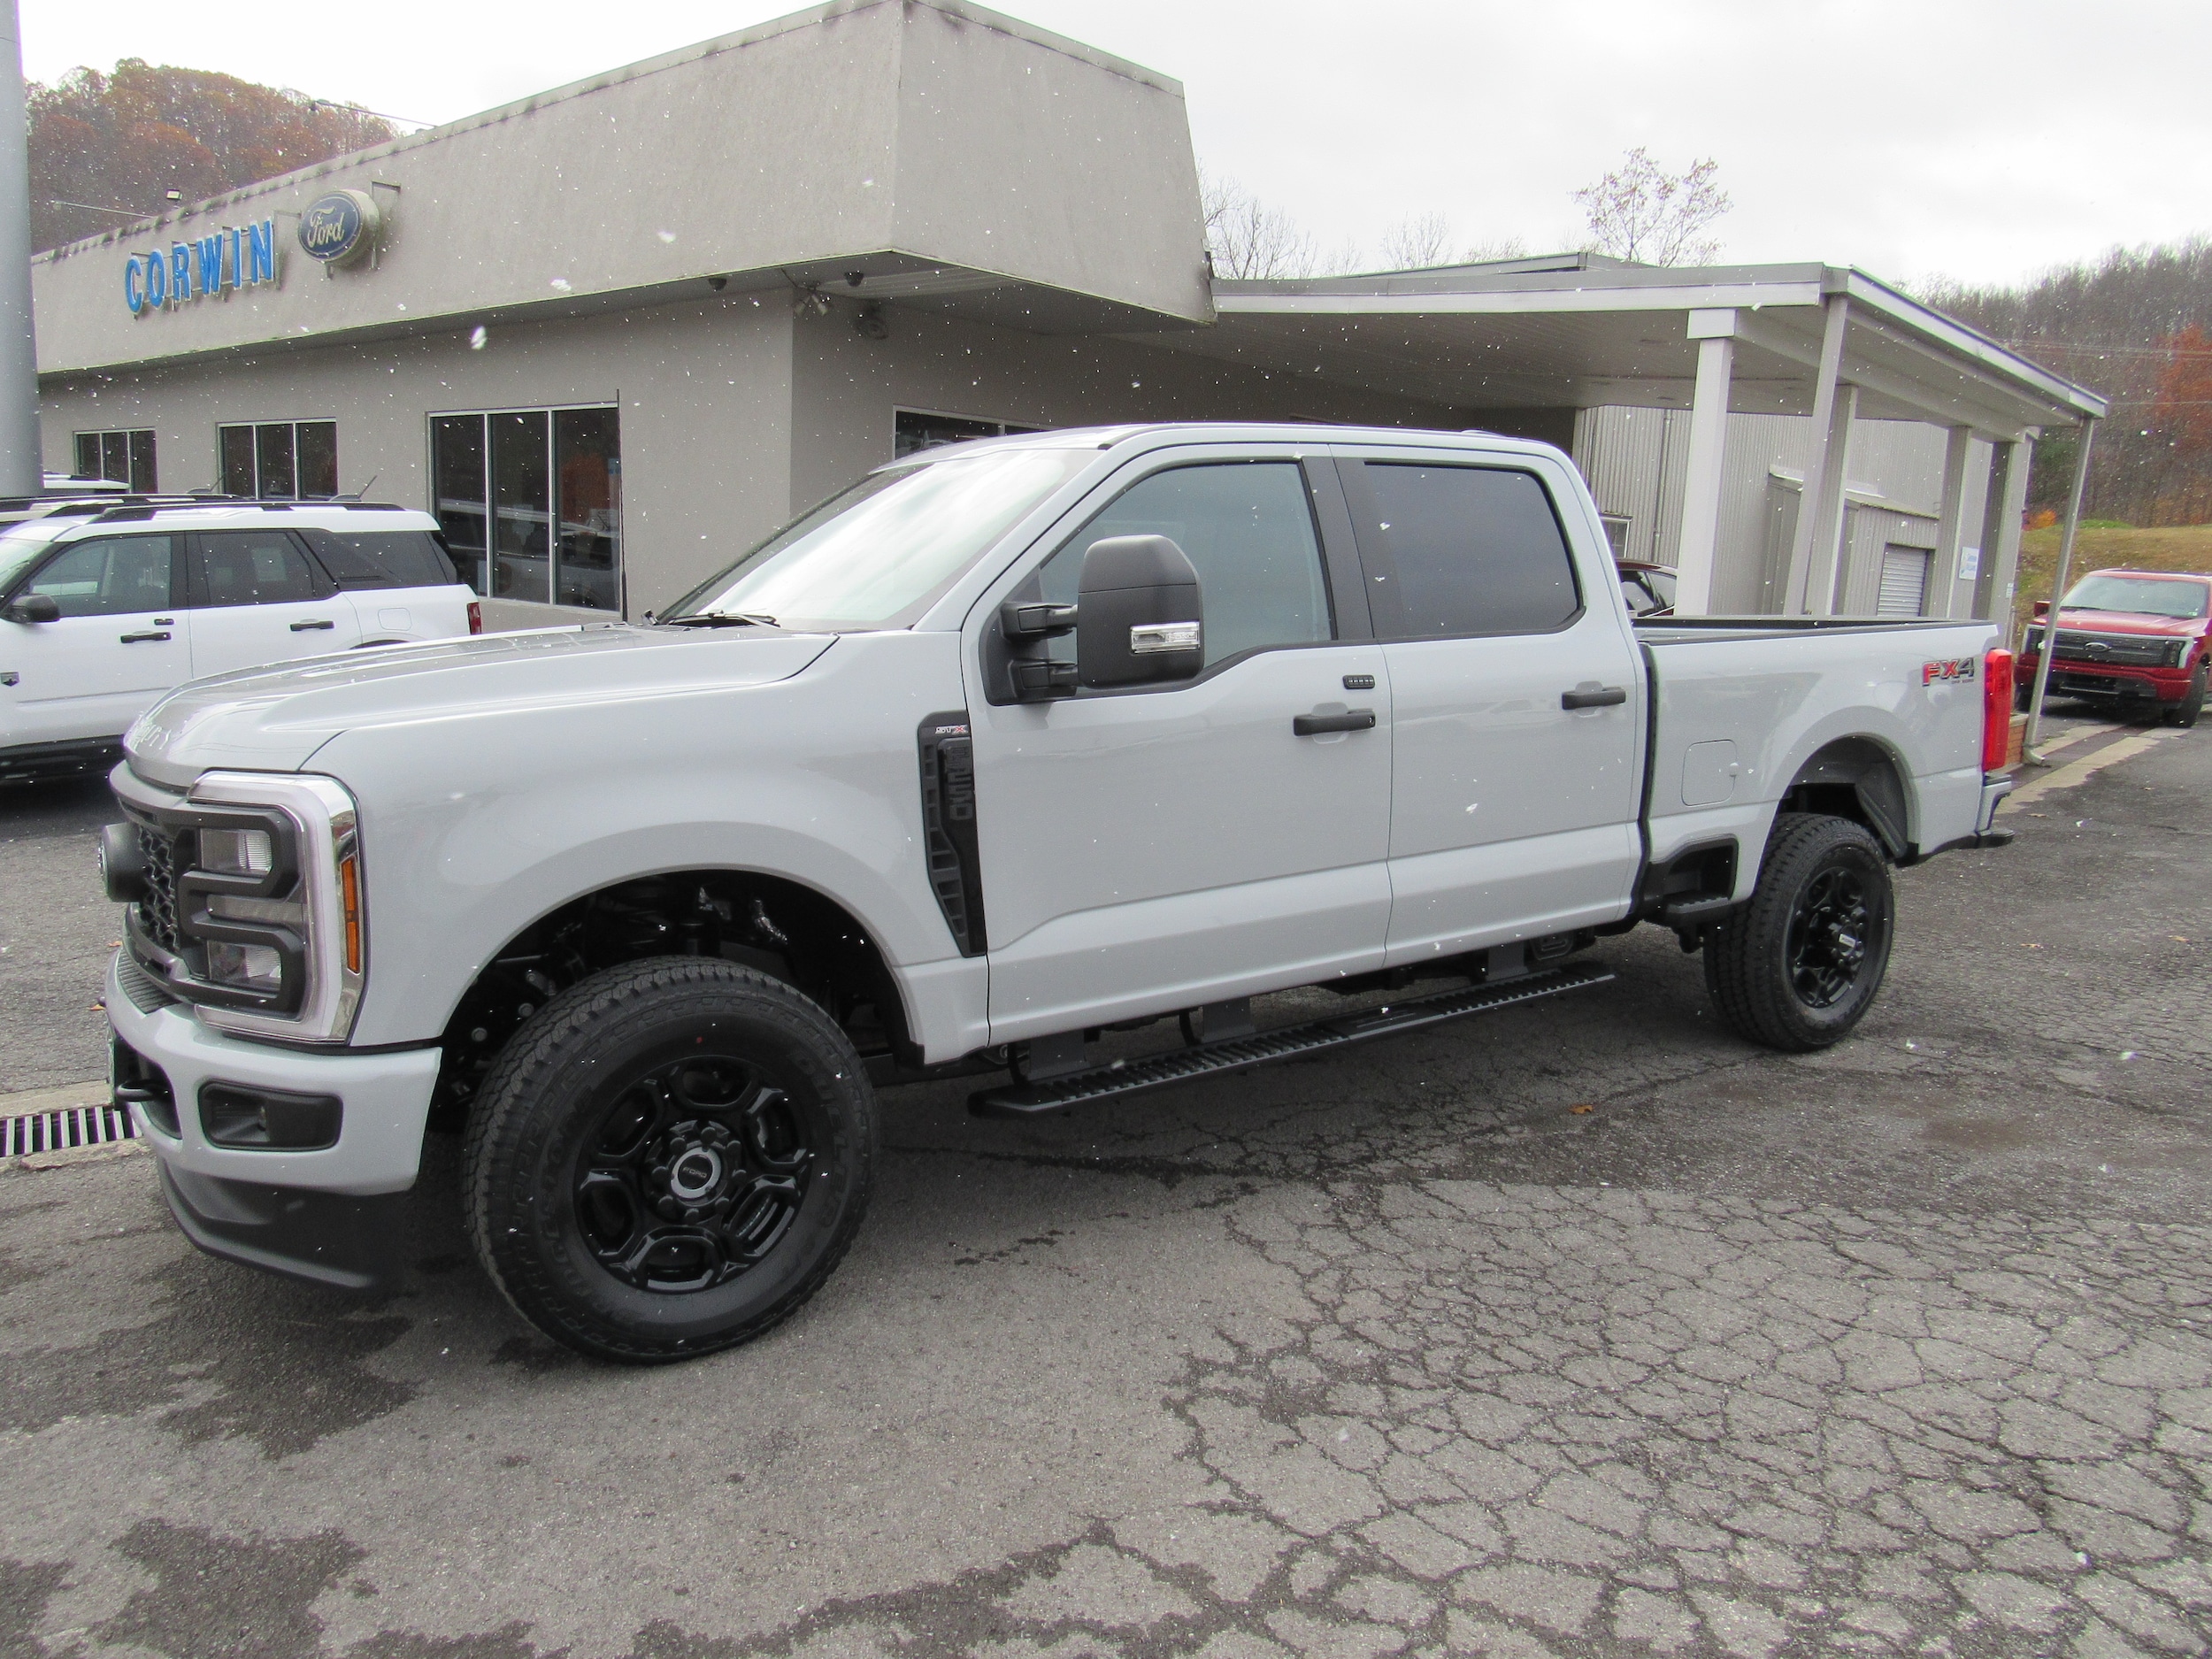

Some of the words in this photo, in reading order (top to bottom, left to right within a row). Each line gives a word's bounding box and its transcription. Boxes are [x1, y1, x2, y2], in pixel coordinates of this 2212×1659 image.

[306, 206, 345, 248] Ford
[125, 217, 274, 314] CORWIN
[1922, 657, 1975, 687] FX4
[683, 1167, 707, 1179] FORD
